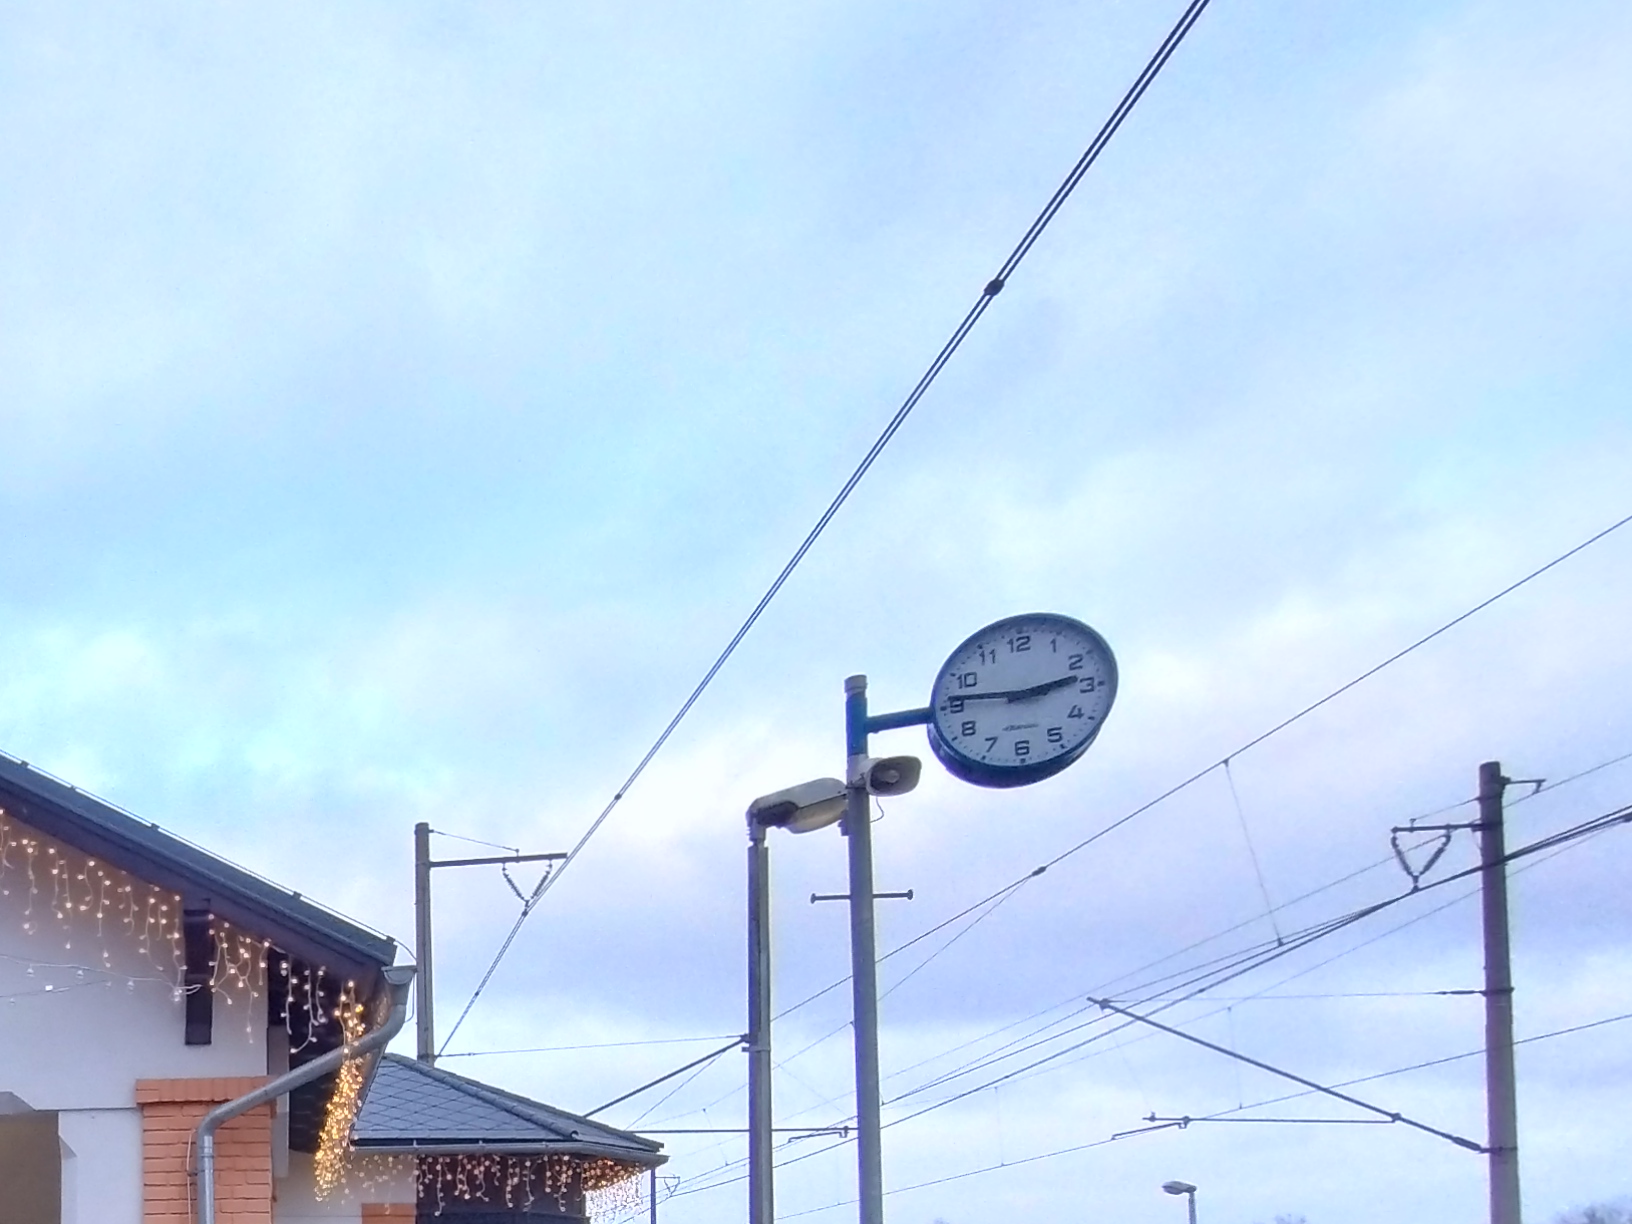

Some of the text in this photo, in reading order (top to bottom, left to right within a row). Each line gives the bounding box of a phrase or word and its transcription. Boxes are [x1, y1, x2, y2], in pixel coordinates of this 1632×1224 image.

[1006, 635, 1031, 653] 12
[1049, 638, 1058, 653] 1
[978, 648, 997, 666] 11
[1068, 653, 1084, 671] 2
[956, 671, 978, 689] 10
[1079, 676, 1095, 694] 3
[949, 697, 965, 714] 9
[1067, 704, 1085, 720] 4
[961, 720, 977, 737] 8
[1047, 726, 1063, 743] 5
[984, 736, 999, 753] 7
[1014, 740, 1030, 756] 6
